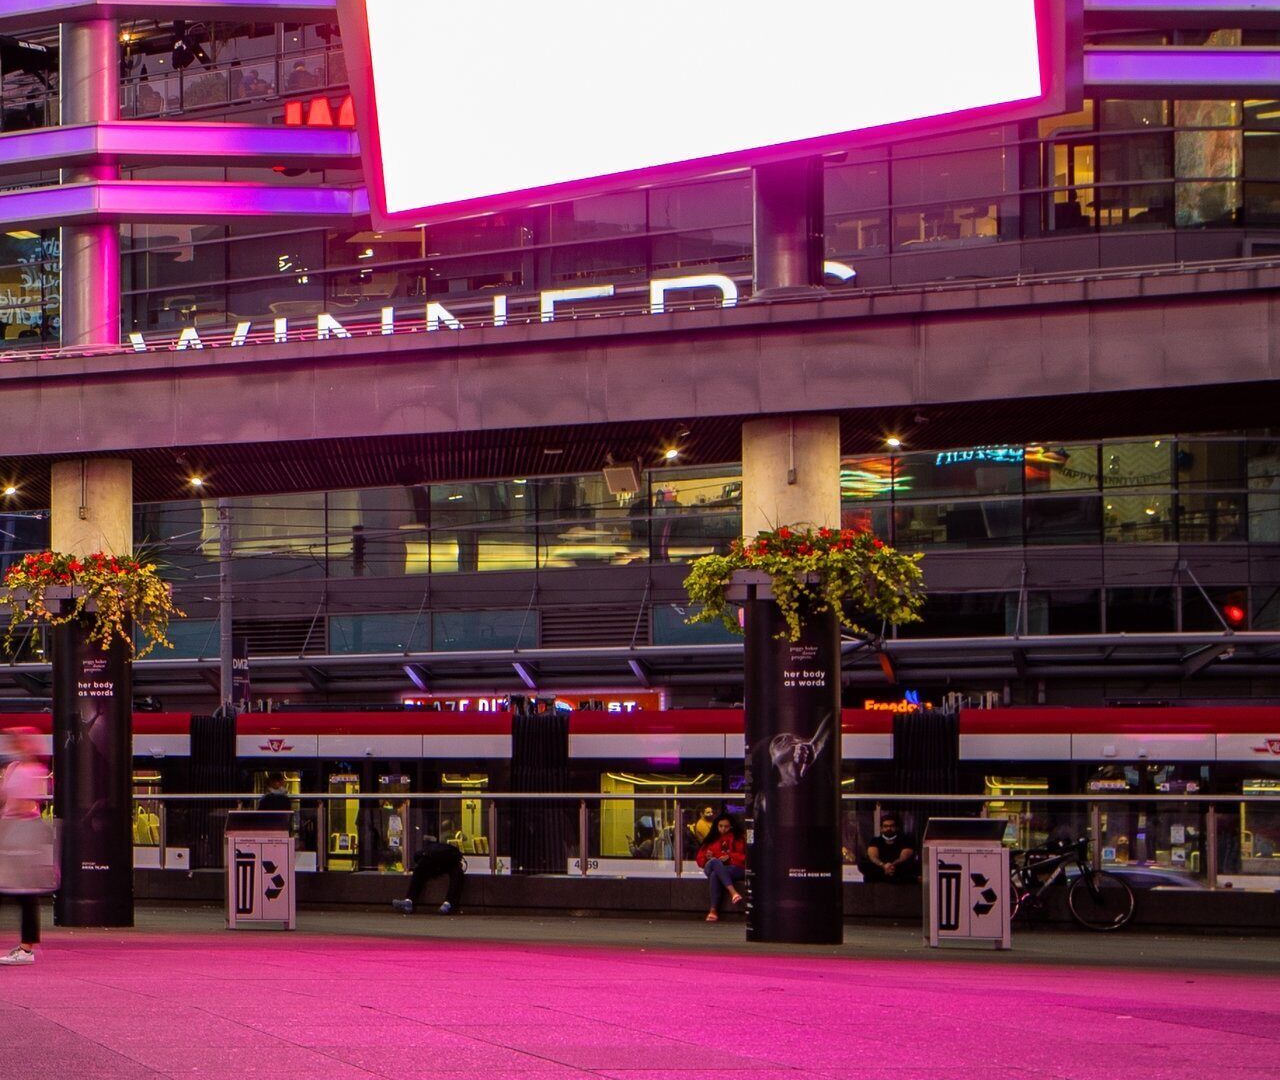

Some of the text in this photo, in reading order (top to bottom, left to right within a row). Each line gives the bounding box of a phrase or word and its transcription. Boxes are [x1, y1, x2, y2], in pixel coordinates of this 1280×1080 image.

[783, 670, 826, 681] her body
[93, 682, 114, 690] body
[798, 679, 826, 687] words
[90, 689, 114, 697] words
[573, 860, 599, 870] 469
